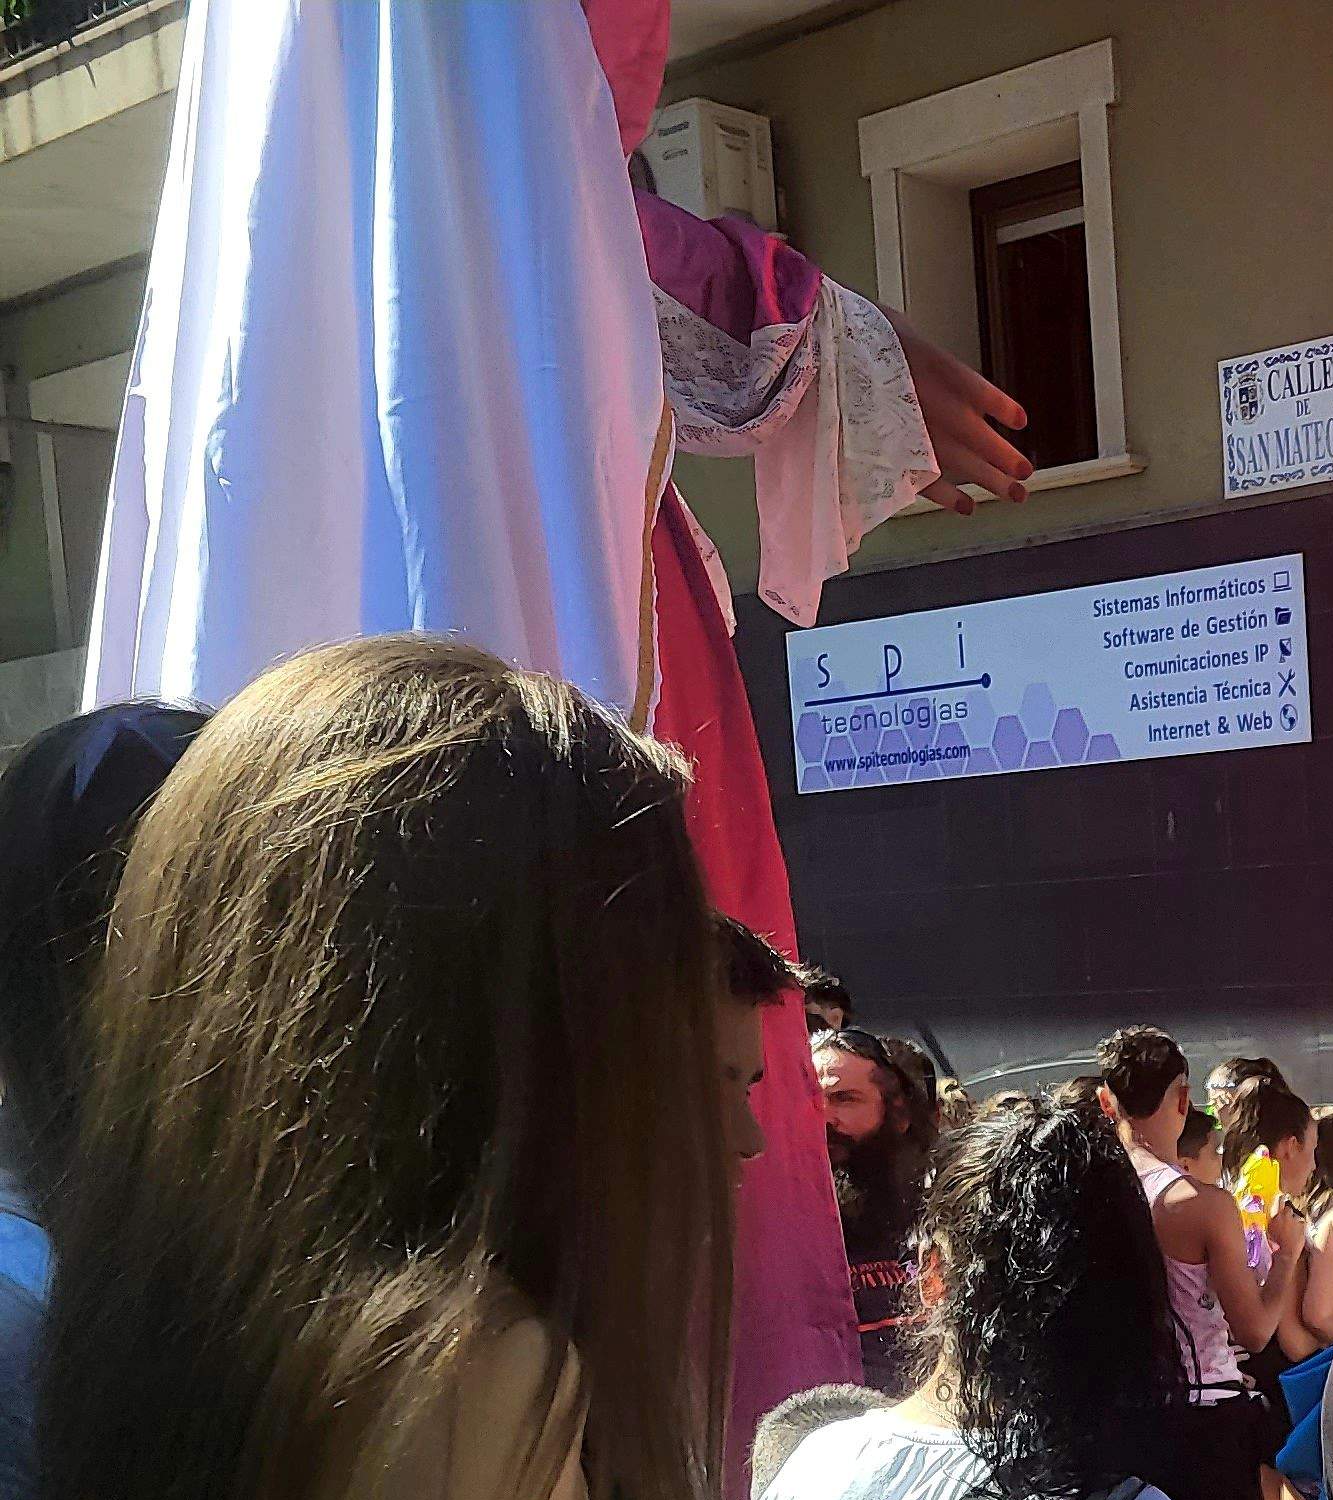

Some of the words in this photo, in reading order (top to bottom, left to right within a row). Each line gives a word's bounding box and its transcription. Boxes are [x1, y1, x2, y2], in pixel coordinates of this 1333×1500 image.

[1296, 398, 1311, 417] DE
[1236, 432, 1270, 476] SAN
[1093, 591, 1160, 618] Sistemas
[1166, 576, 1266, 609] Informáticos
[1103, 623, 1175, 649] Software
[1181, 620, 1200, 639] de
[1206, 609, 1269, 635] Gestión
[1124, 649, 1249, 678] Comunicaciones
[1254, 644, 1270, 663] IP
[1129, 686, 1208, 712] Asistencia
[1213, 678, 1272, 704] Técnica
[822, 697, 969, 736] tecnologías
[1148, 718, 1212, 742] Internet
[1217, 715, 1230, 734] &
[1237, 711, 1273, 732] Web
